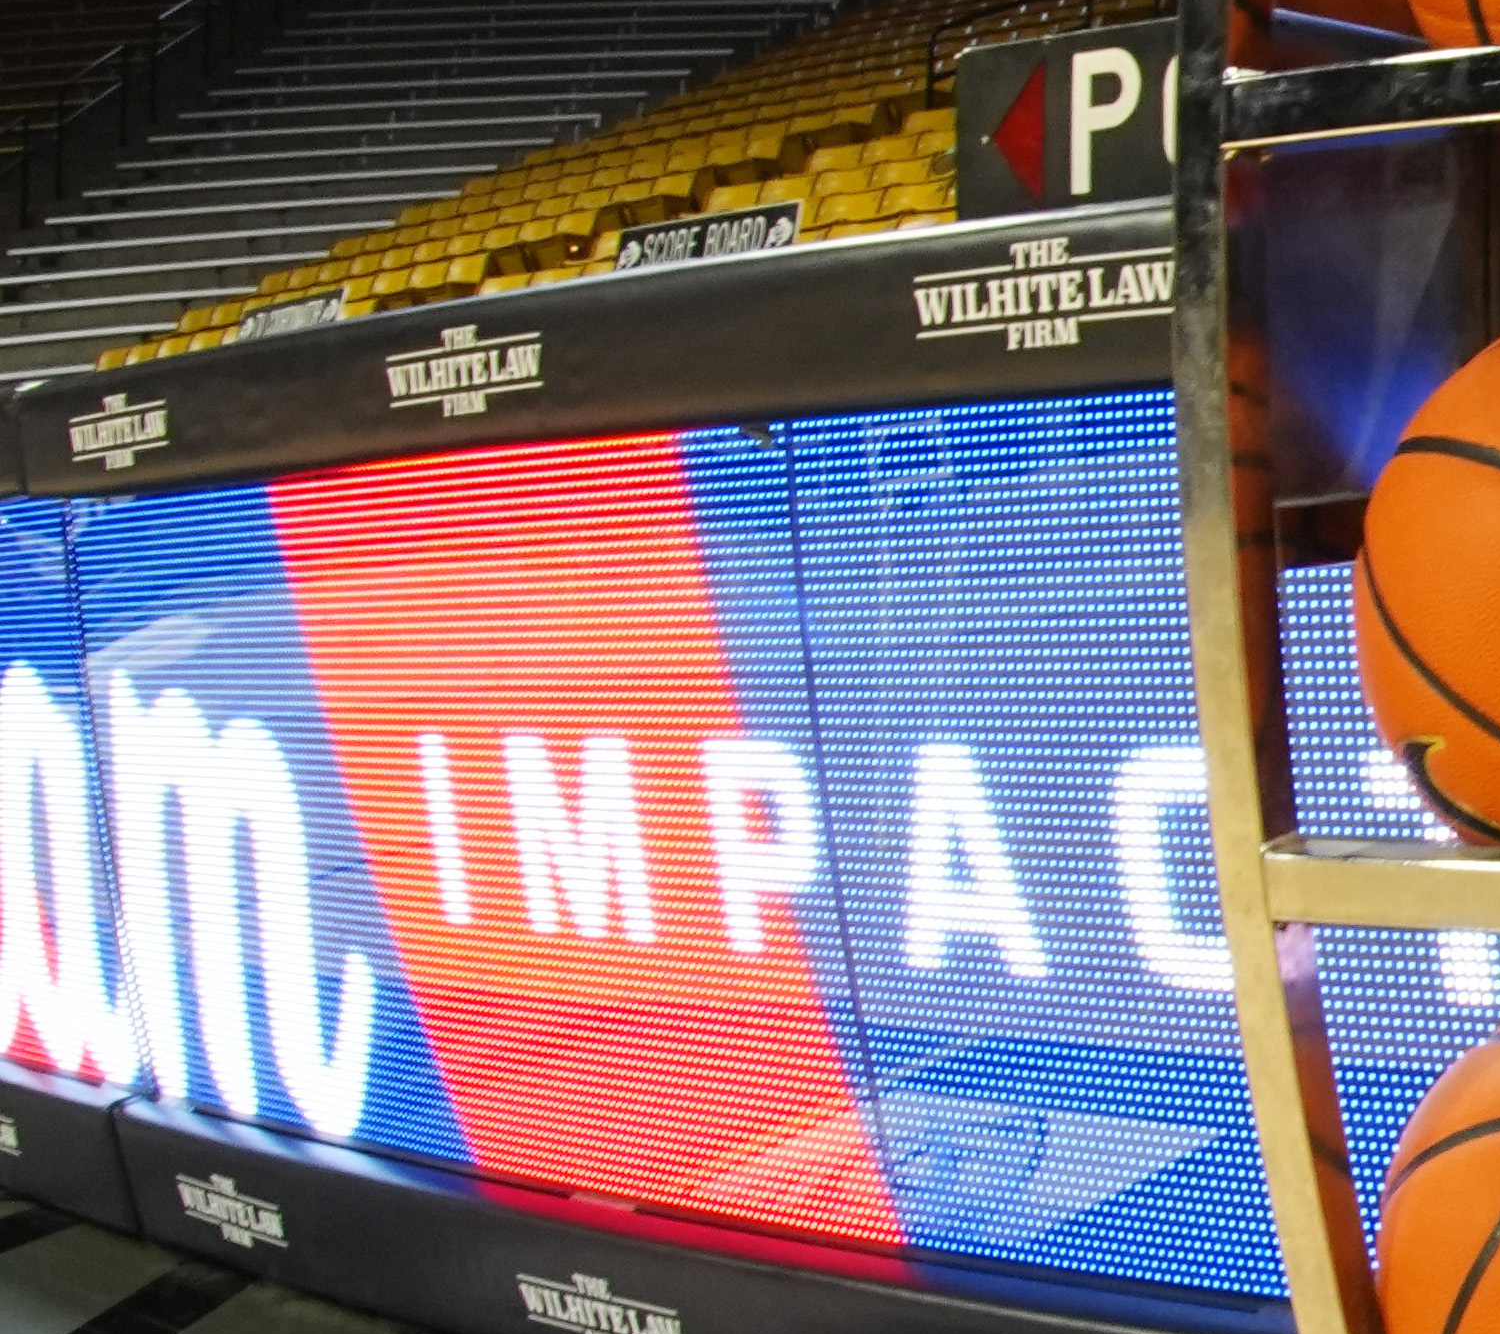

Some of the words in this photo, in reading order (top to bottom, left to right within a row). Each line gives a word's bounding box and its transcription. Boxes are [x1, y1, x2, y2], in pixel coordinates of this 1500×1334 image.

[1010, 237, 1069, 269] THE
[914, 269, 1084, 328] WILHITE
[1085, 261, 1176, 308] LAW
[441, 324, 478, 351] THE
[1006, 317, 1079, 350] FIRM
[386, 352, 488, 398] WILHITE
[489, 344, 542, 381] LAW
[571, 1271, 611, 1301] THE
